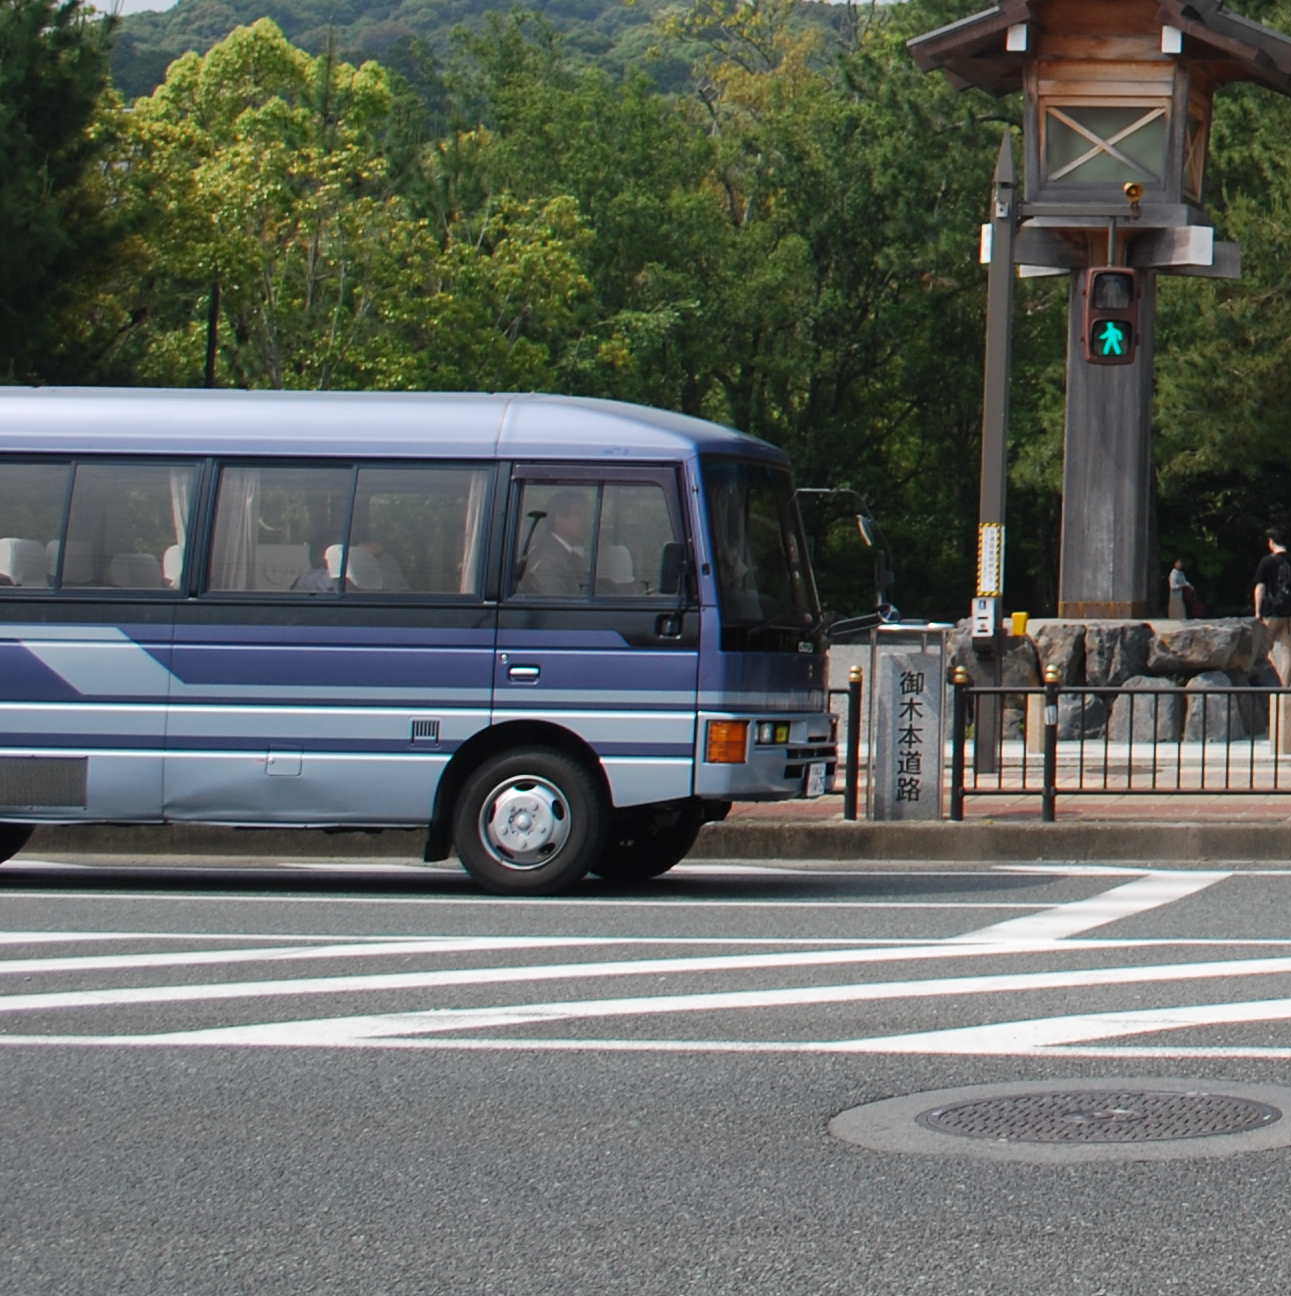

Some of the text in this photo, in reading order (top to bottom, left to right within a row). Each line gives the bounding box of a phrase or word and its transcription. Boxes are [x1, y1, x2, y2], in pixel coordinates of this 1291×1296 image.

[896, 670, 925, 802] 御木本道路
